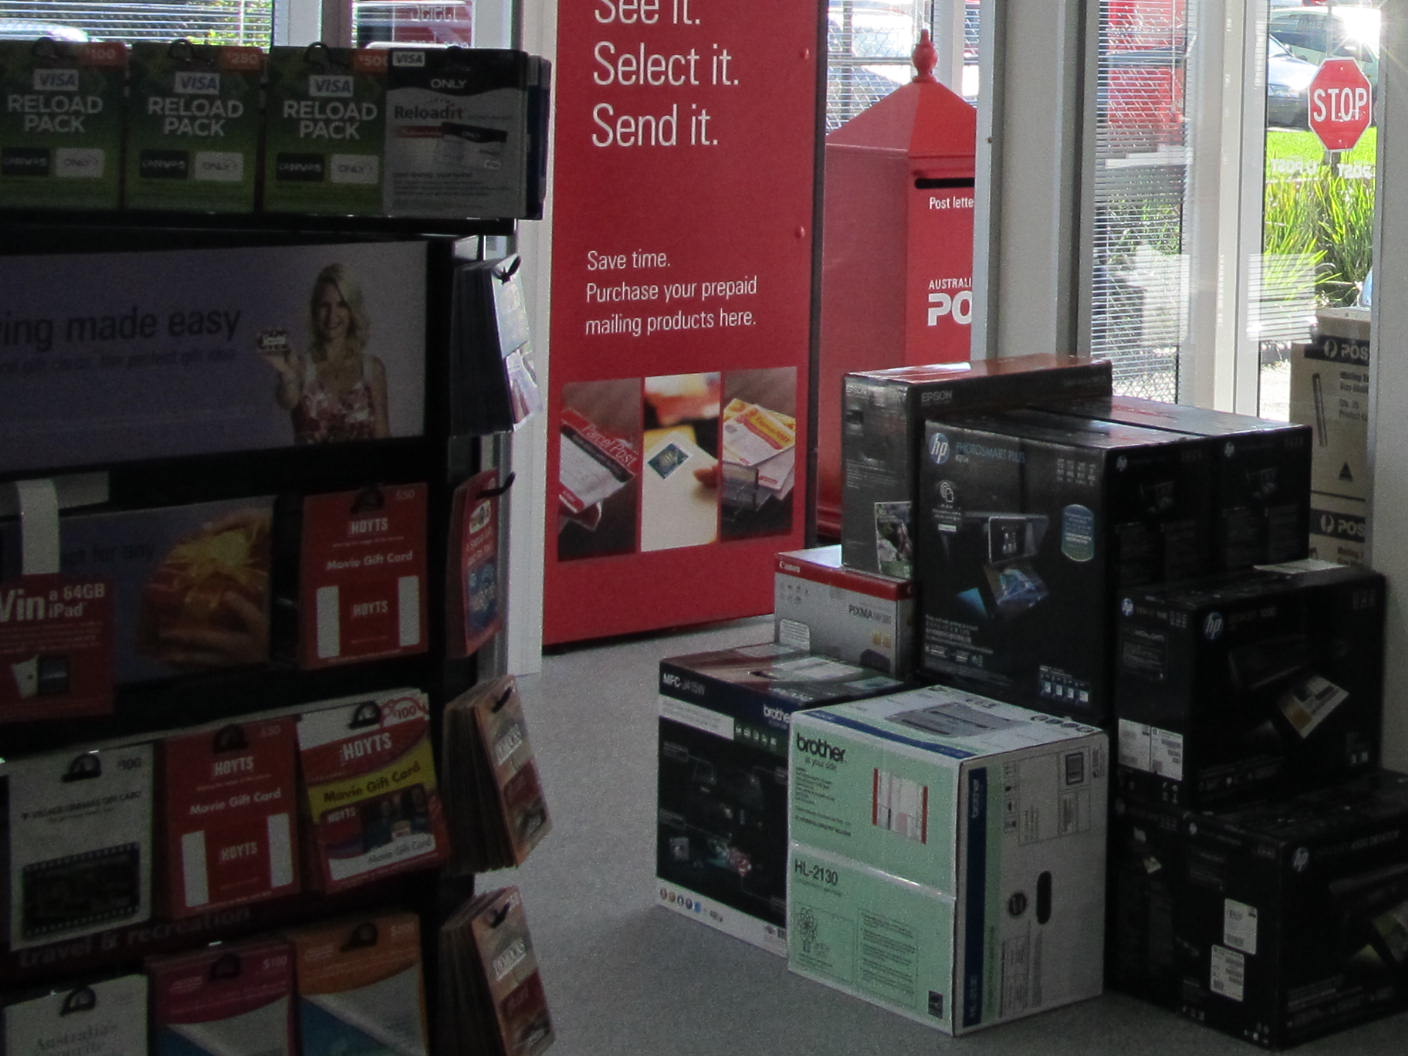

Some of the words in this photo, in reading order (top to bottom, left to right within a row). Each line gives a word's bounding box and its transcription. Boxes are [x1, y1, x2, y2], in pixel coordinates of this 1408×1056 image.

[396, 54, 423, 65] VISA
[593, 41, 700, 86] Select
[712, 44, 739, 86] it.
[39, 72, 77, 87] VISA
[181, 75, 218, 91] VISA
[314, 78, 352, 94] VISA
[429, 77, 469, 90] ONLY
[8, 96, 104, 115] RELOAD
[147, 97, 245, 119] RELOAD
[283, 100, 378, 121] RELOAD
[1313, 88, 1367, 123] STOP
[24, 114, 86, 134] PACK
[163, 117, 227, 137] PACK
[299, 120, 362, 141] PACK
[592, 103, 677, 147] Send
[691, 104, 719, 146] it.
[929, 196, 950, 210] Post
[952, 196, 975, 210] lette
[587, 250, 627, 272] Save
[632, 248, 671, 269] time.
[586, 281, 659, 304] Purchase
[664, 283, 697, 304] your
[701, 275, 758, 302] prepaid
[928, 277, 973, 291] AUSTRALI
[927, 290, 973, 327] PO
[0, 310, 54, 352] ing
[65, 305, 159, 343] made
[167, 307, 241, 342] easy
[585, 313, 643, 337] mailing
[647, 310, 715, 337] products
[719, 307, 757, 328] here.
[1340, 344, 1370, 361] POS
[931, 433, 949, 464] hp
[351, 518, 389, 535] HOYTS
[1338, 522, 1366, 538] POS
[326, 556, 361, 572] Movie
[363, 553, 385, 566] Gift
[387, 550, 414, 564] Card
[63, 583, 106, 600] 64GB
[49, 602, 85, 619] iPad
[352, 600, 389, 617] HOYTS
[848, 604, 873, 620] PIXMA
[1204, 611, 1224, 640] hp
[763, 703, 791, 724] brothe
[343, 733, 393, 759] HOYTS
[796, 732, 847, 763] brother
[214, 756, 255, 776] HOYTS
[322, 782, 363, 803] Movie
[366, 775, 390, 794] Gift
[392, 760, 421, 784] Card
[189, 800, 227, 816] Movie
[228, 794, 252, 809] Gift
[253, 788, 283, 804] Card
[327, 808, 357, 825] HOYTS
[221, 842, 258, 862] HOYTS
[794, 858, 840, 888] HL-2130
